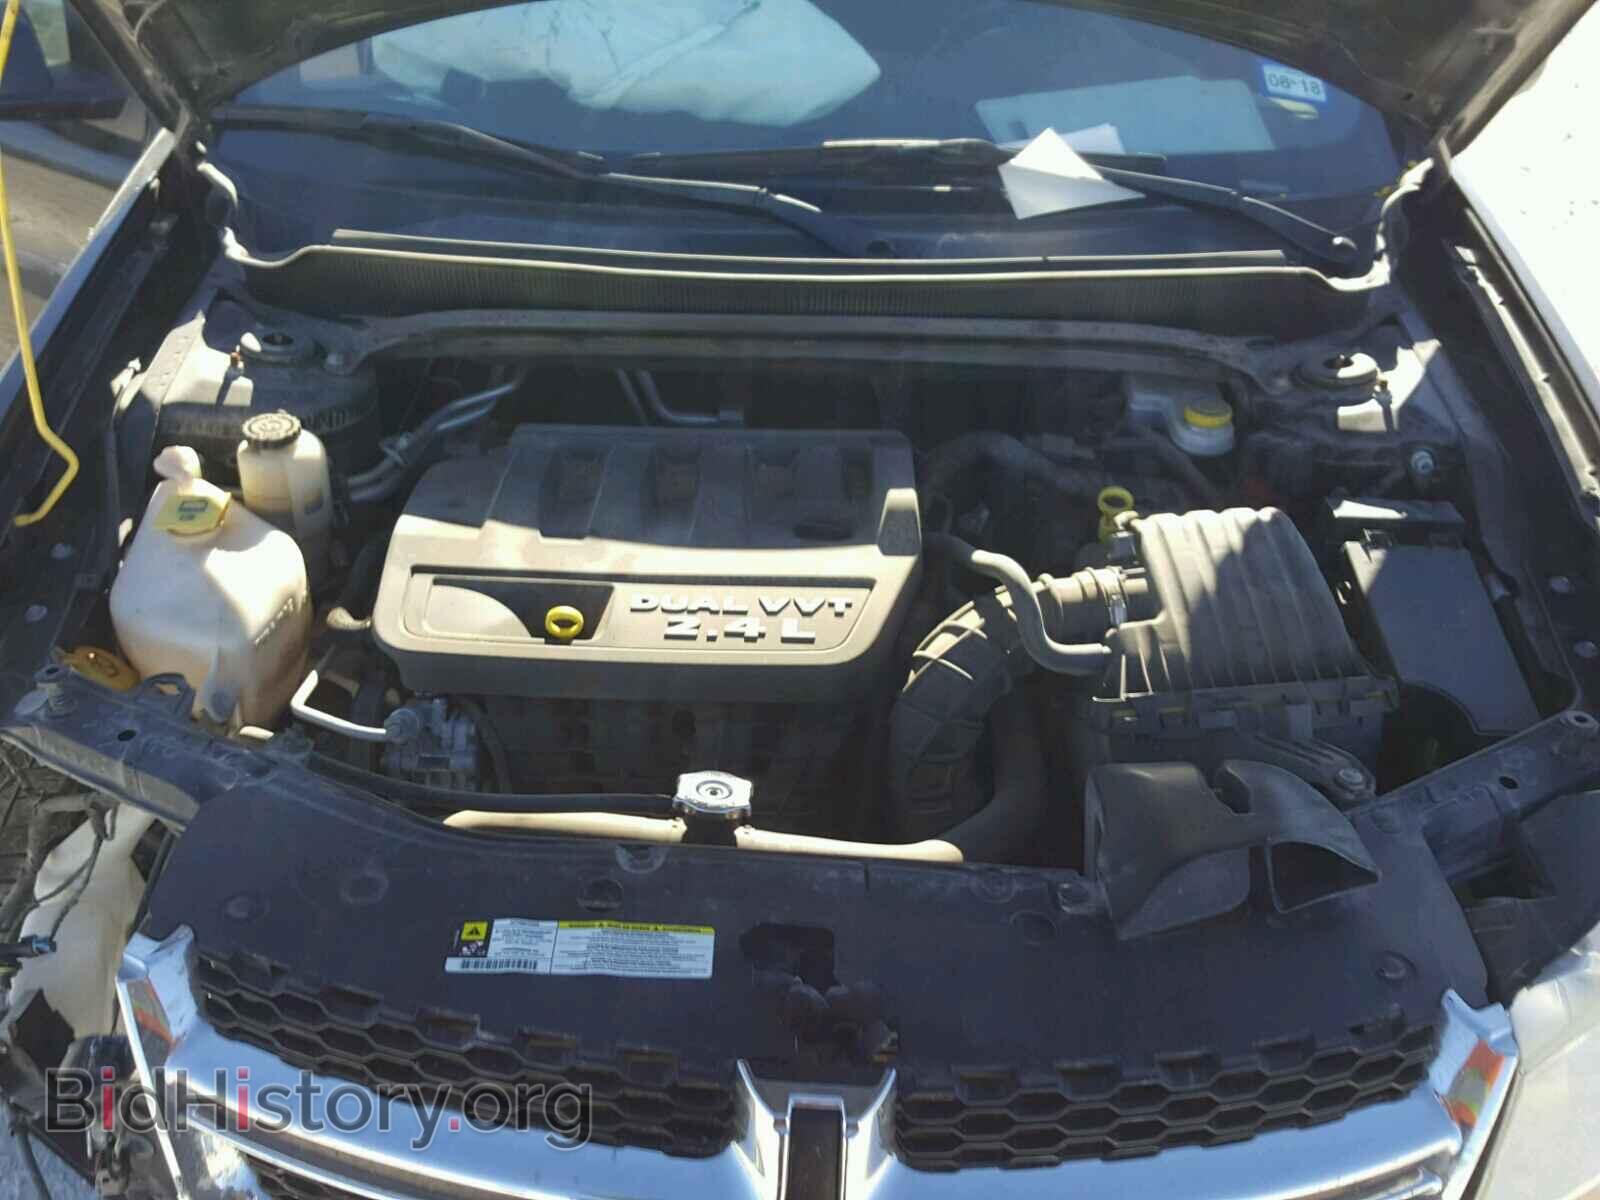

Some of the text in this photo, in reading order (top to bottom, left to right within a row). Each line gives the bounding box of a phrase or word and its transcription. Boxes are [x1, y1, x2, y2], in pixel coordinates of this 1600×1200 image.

[630, 593, 853, 618] DUAL VVT
[663, 617, 816, 643] 2.4L
